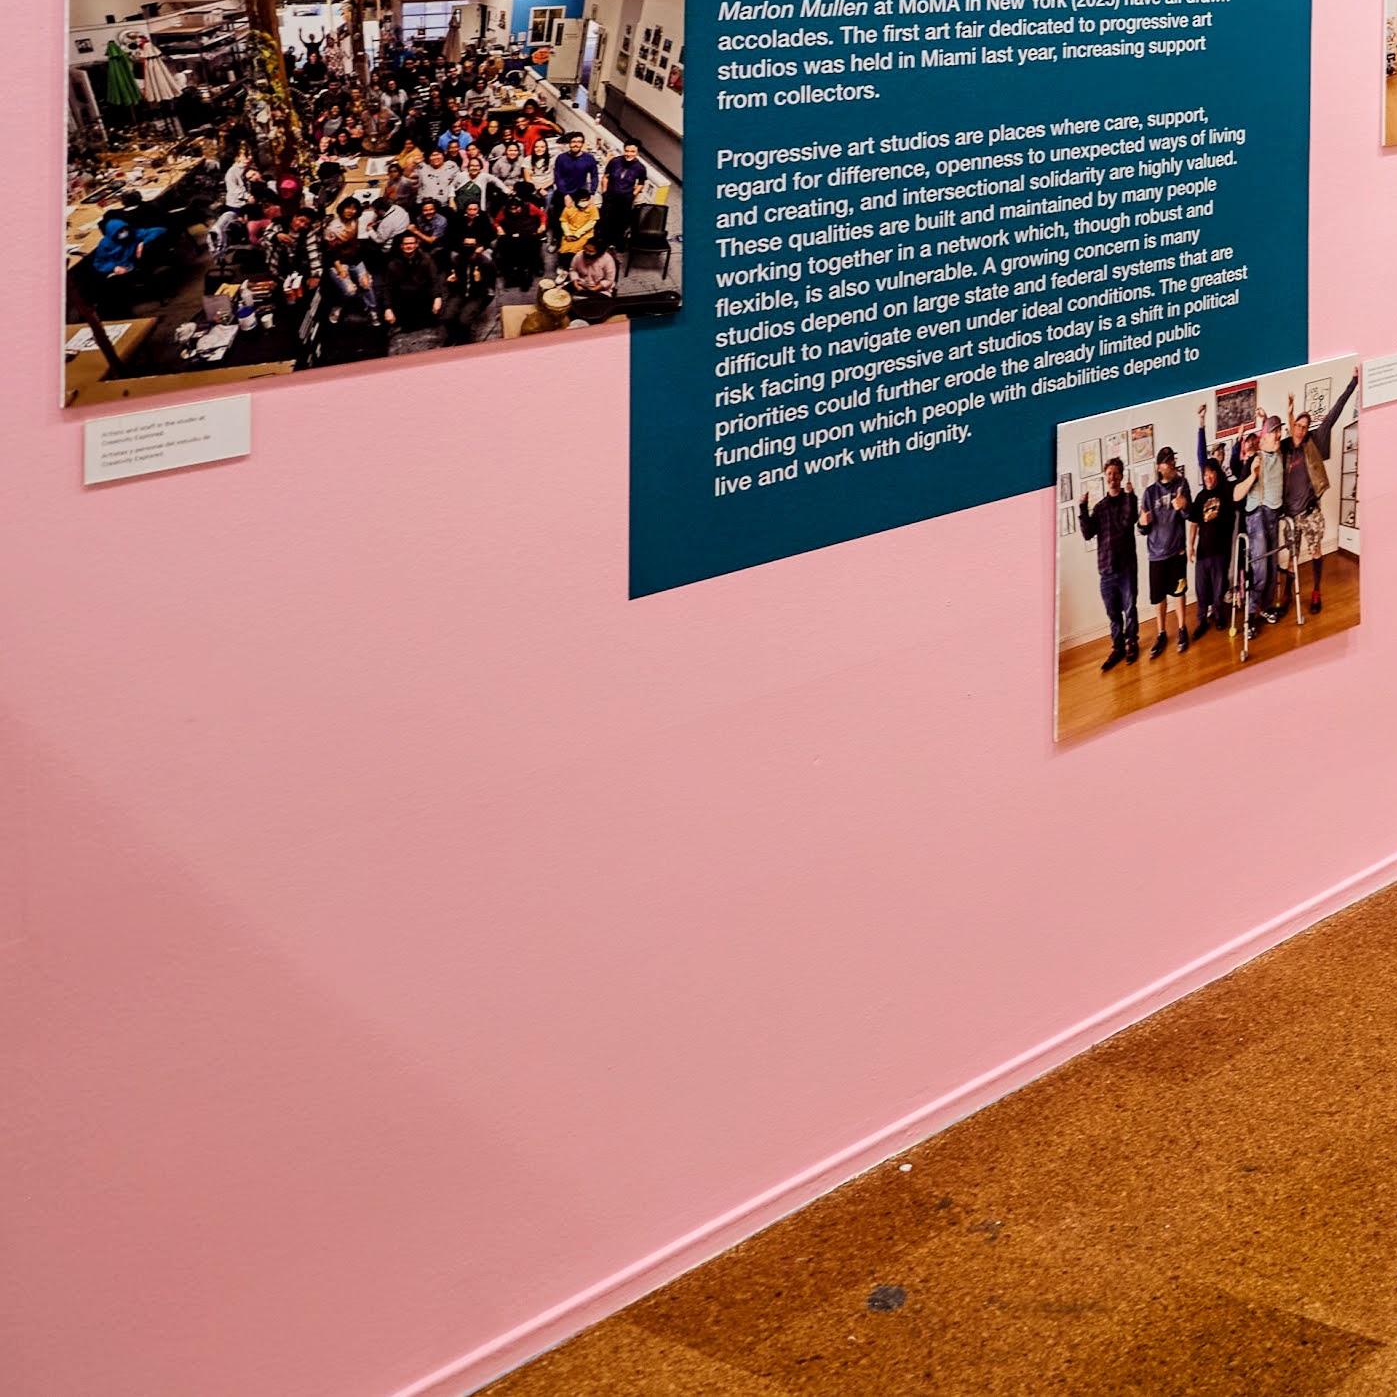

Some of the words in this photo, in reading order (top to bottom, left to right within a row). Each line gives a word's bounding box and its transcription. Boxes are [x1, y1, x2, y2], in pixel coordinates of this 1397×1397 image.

[716, 173, 787, 202] regard
[791, 171, 824, 191] for
[826, 162, 931, 187] difference,
[935, 152, 1025, 178] openness
[1026, 147, 1047, 165] to
[1049, 135, 1146, 163] unexpected
[1148, 134, 1188, 153] ways
[1189, 129, 1207, 147] of
[1208, 126, 1247, 146] living
[717, 140, 843, 171] Progressive
[847, 136, 876, 157] art
[879, 130, 951, 154] studios
[954, 130, 985, 147] are
[988, 123, 1047, 147] places
[1049, 118, 1102, 137] where
[1103, 115, 1144, 132] care,
[1146, 106, 1209, 129] support,
